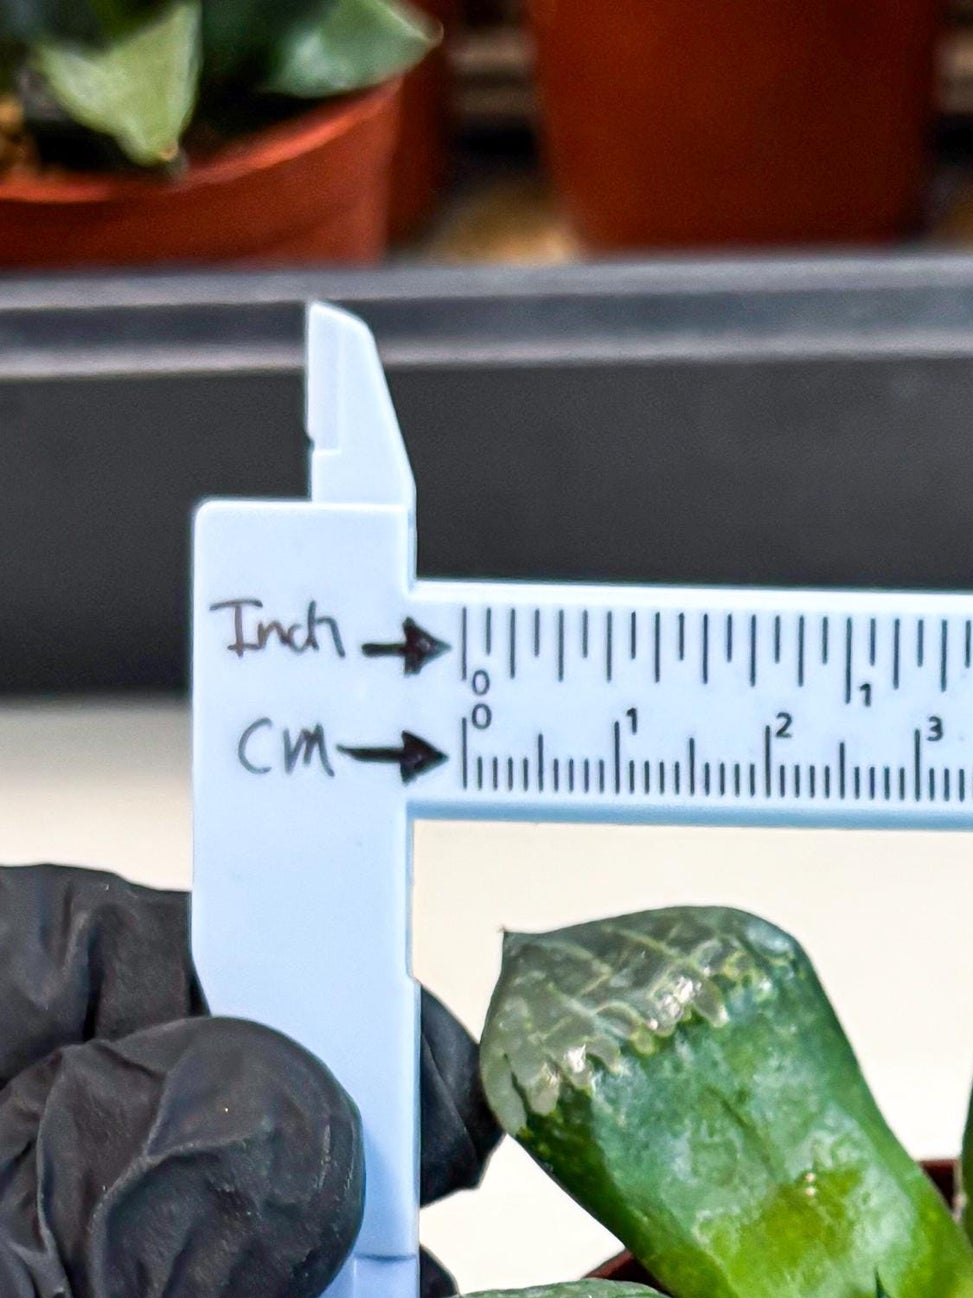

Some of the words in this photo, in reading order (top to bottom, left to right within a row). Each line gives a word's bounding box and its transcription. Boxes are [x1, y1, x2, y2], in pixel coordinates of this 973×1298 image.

[209, 599, 347, 658] Inch
[470, 669, 492, 696] 0
[858, 682, 874, 708] 1
[470, 703, 493, 730] 0
[624, 707, 638, 734] 1
[775, 712, 794, 738] 2
[926, 716, 944, 742] 3
